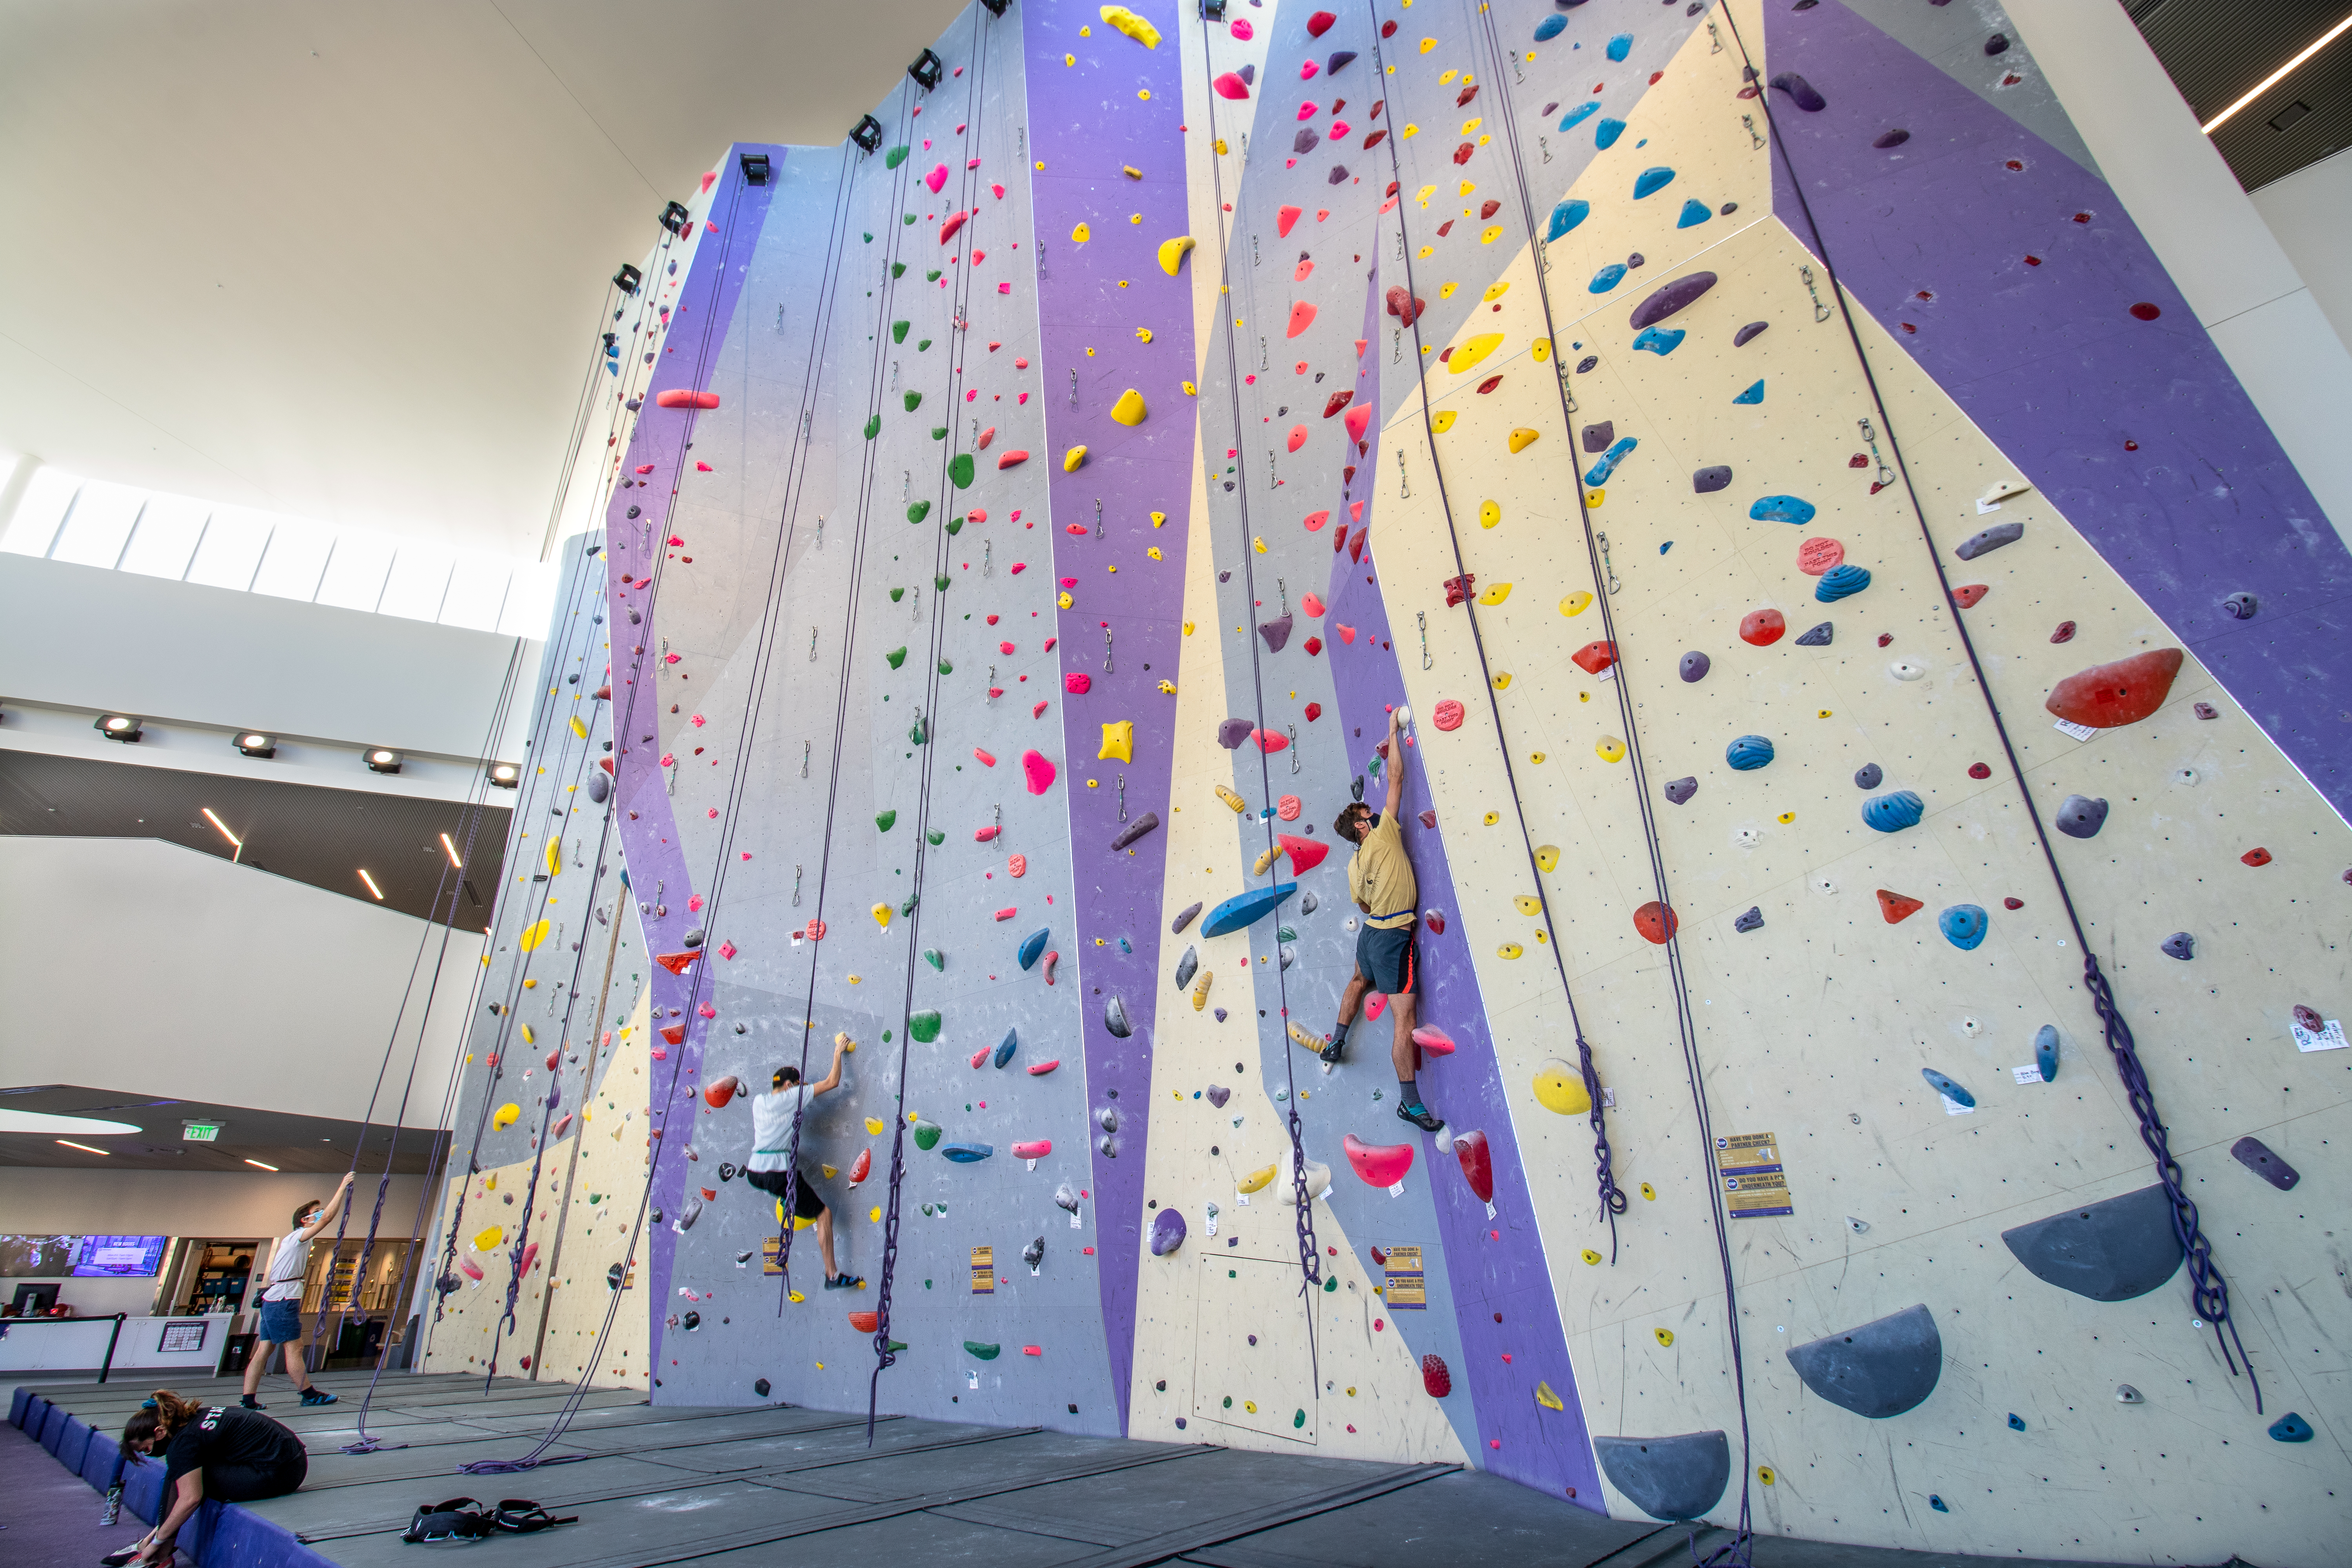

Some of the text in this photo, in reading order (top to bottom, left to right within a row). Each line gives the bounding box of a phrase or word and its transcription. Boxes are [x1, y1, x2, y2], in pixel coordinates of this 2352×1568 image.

[1804, 543, 1834, 556] BOULDER
[1804, 557, 1821, 566] PAST
[1812, 558, 1832, 567] POINT
[1437, 705, 1457, 715] BOULDER
[1280, 800, 1295, 808] BOULDER
[190, 1126, 213, 1139] EXIT
